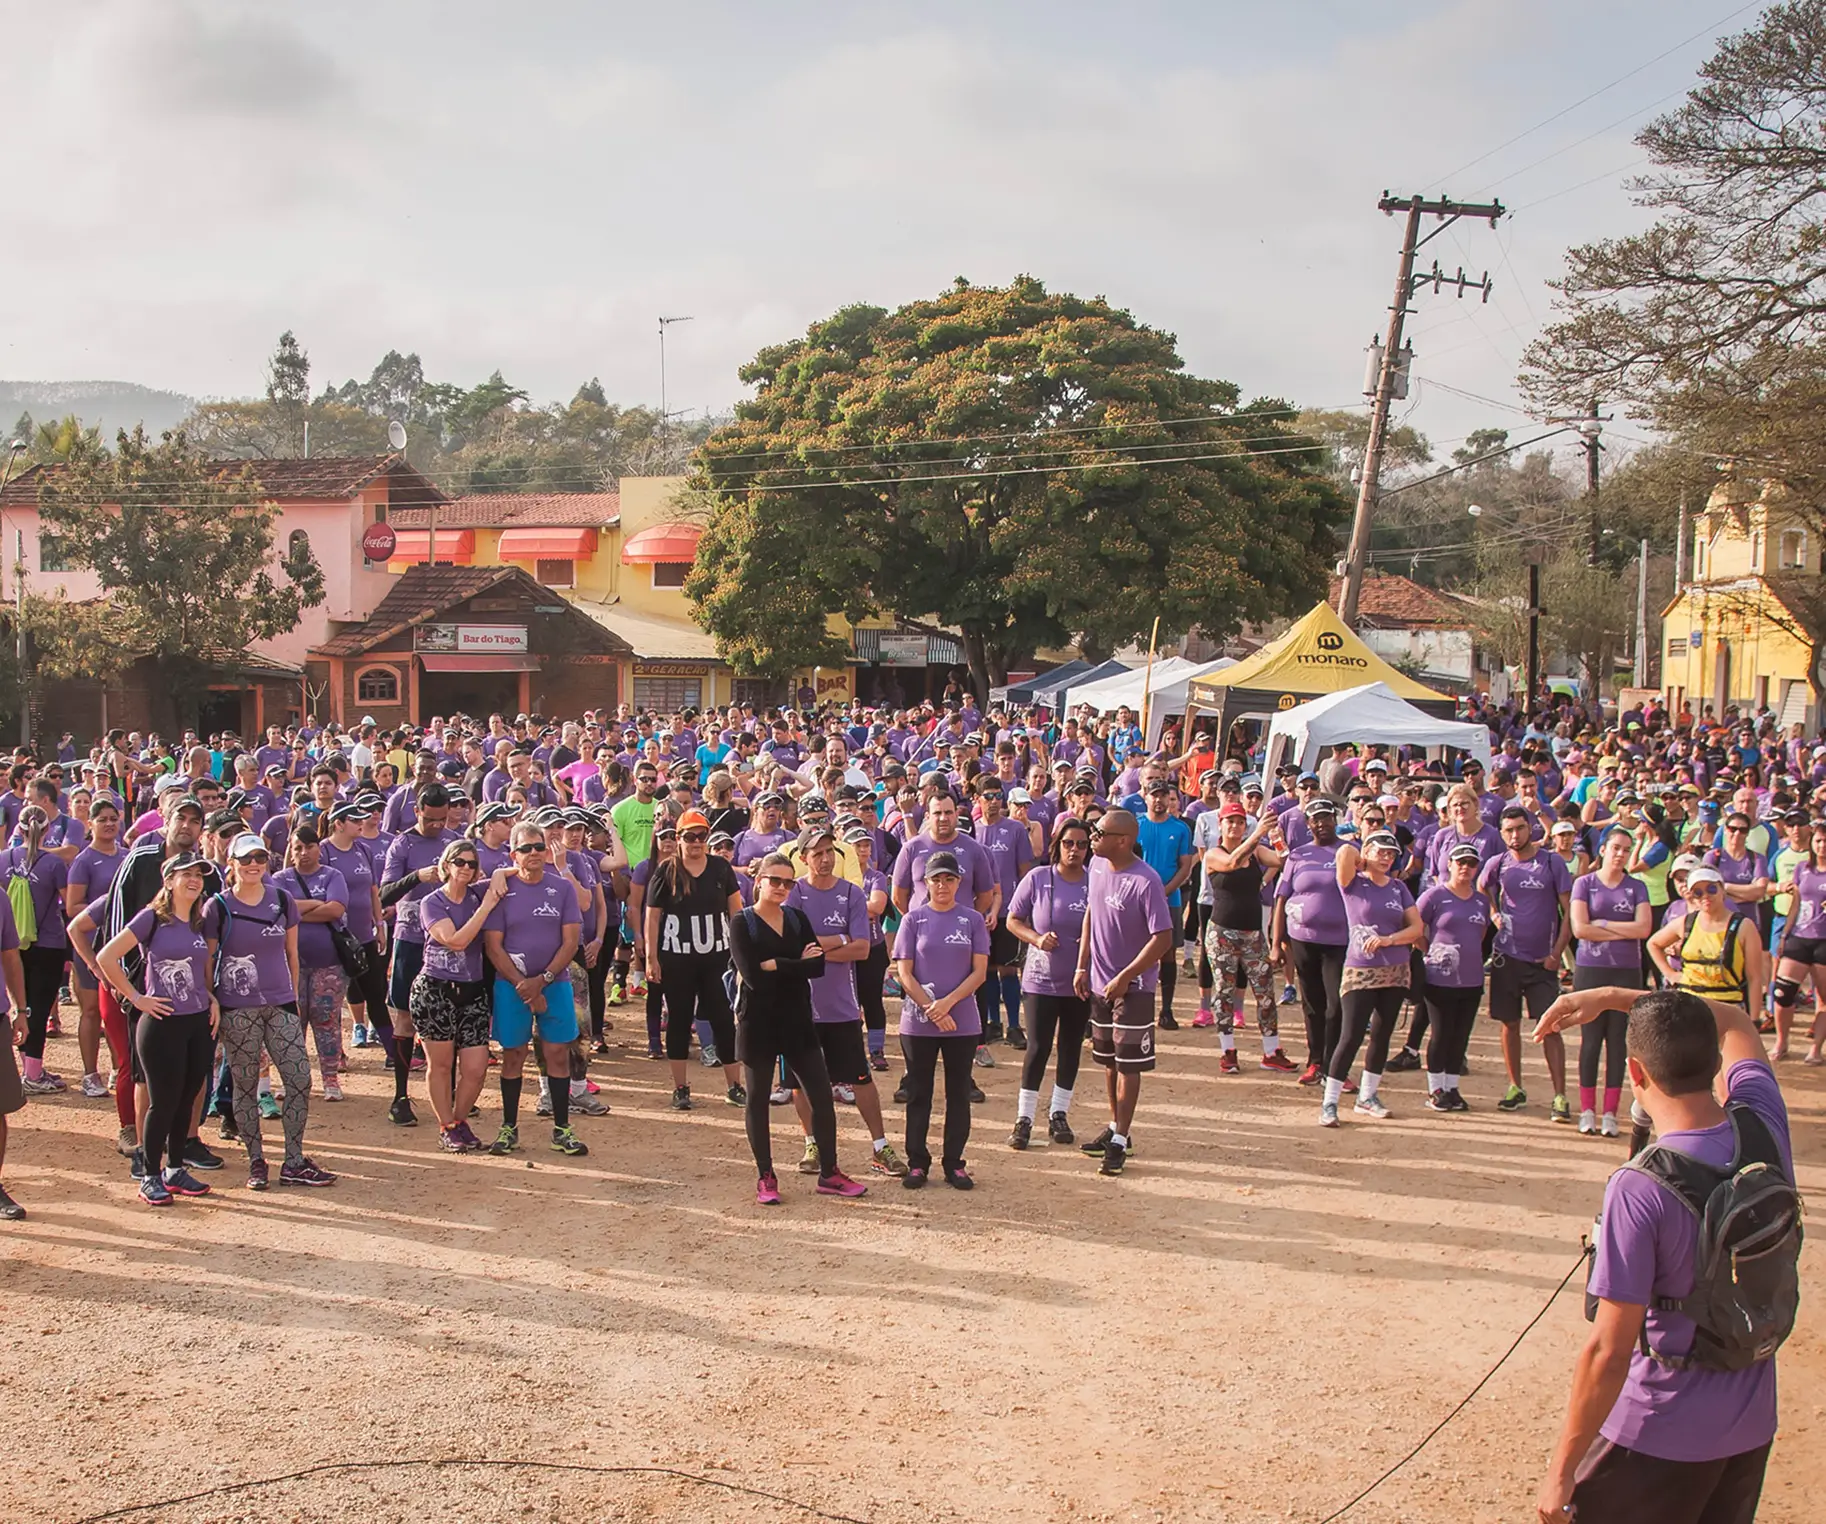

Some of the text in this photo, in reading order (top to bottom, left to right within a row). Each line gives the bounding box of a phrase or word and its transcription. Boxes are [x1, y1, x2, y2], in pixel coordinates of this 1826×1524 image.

[463, 634, 521, 645] Bar do Tiago
[1296, 653, 1368, 668] monaro
[817, 675, 848, 695] BAR
